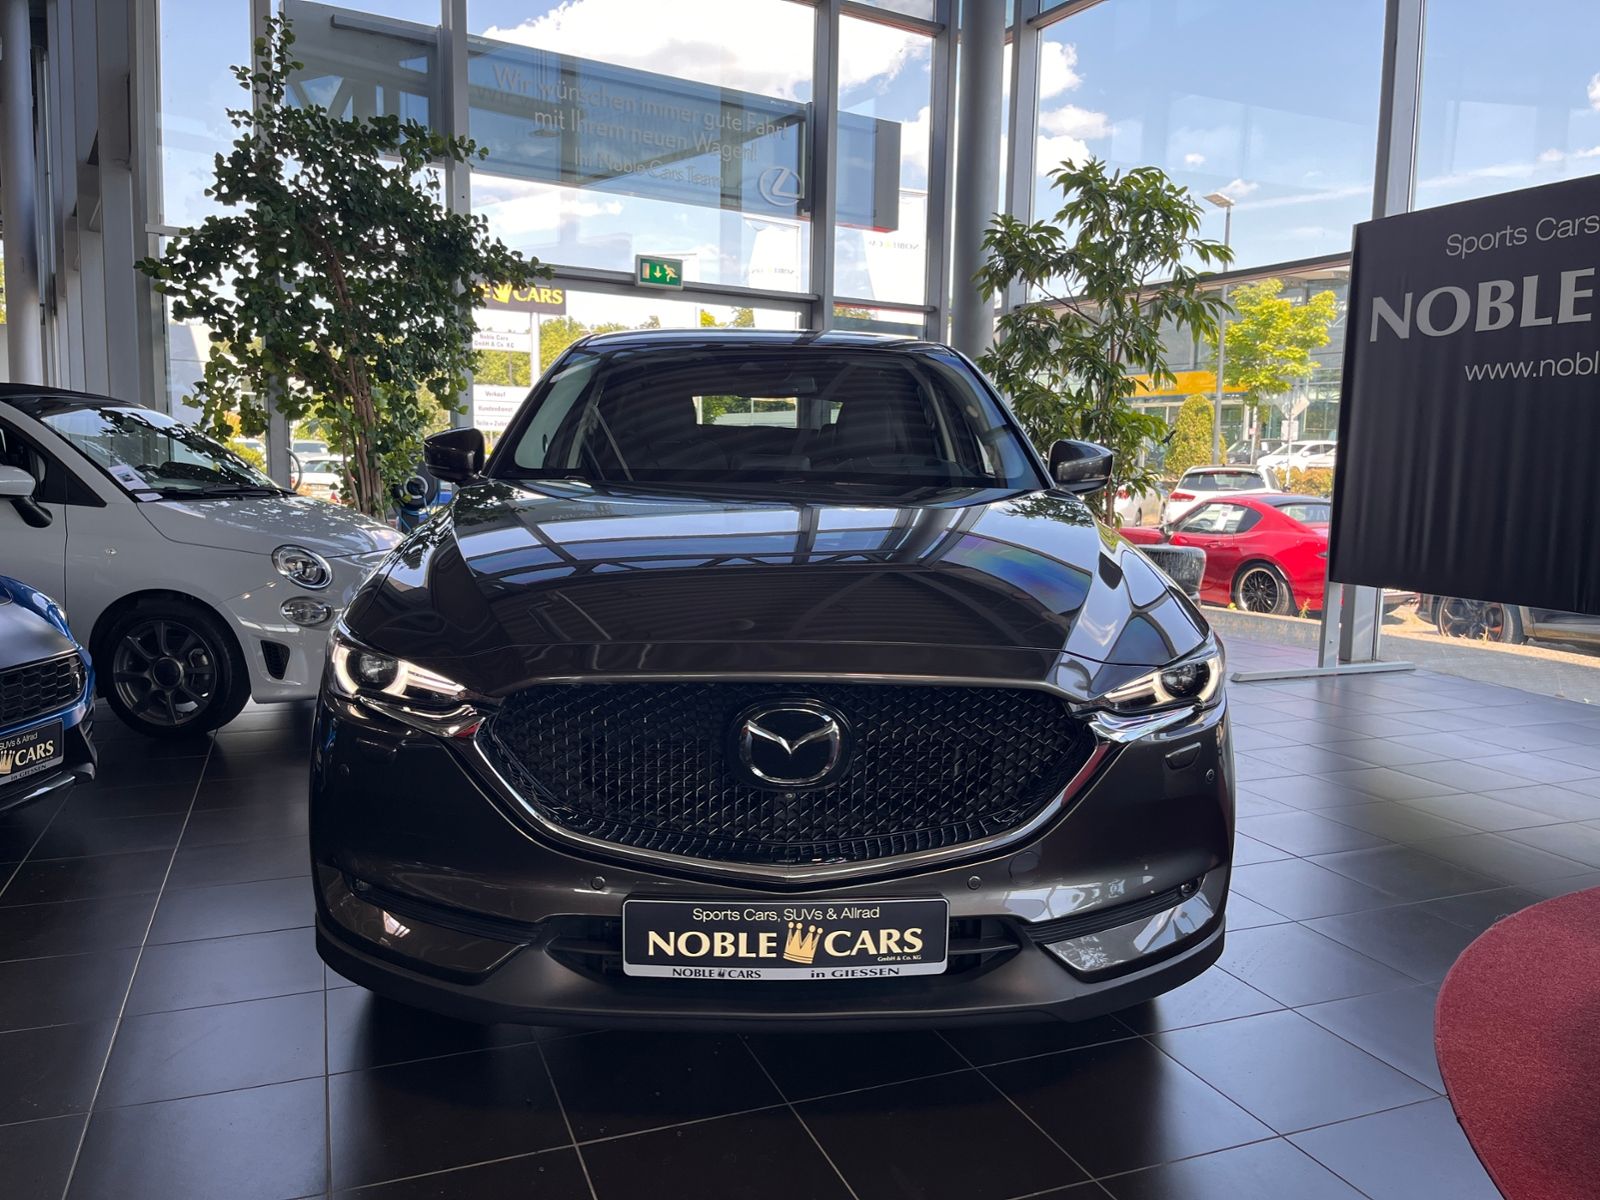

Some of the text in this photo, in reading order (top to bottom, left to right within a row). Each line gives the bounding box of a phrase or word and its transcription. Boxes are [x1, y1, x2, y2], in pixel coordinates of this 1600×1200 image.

[492, 63, 532, 93] Wir
[704, 112, 742, 132] gute
[535, 108, 565, 131] mit
[571, 108, 626, 139] Ihrem
[632, 128, 688, 150] neuen
[597, 151, 646, 174] Noble
[648, 159, 684, 181] Cars
[687, 165, 725, 188] Team
[1446, 225, 1527, 259] Sports
[513, 285, 563, 304] CARS
[1370, 268, 1595, 342] NOBLE
[1464, 350, 1600, 381] www.nobl
[15, 740, 54, 766] CARS
[692, 907, 880, 922] Sports Cars, SUVs & Allrad
[648, 927, 923, 958] NOBLE CARS
[672, 967, 900, 979] NOBLE CARS in GIESSEN
